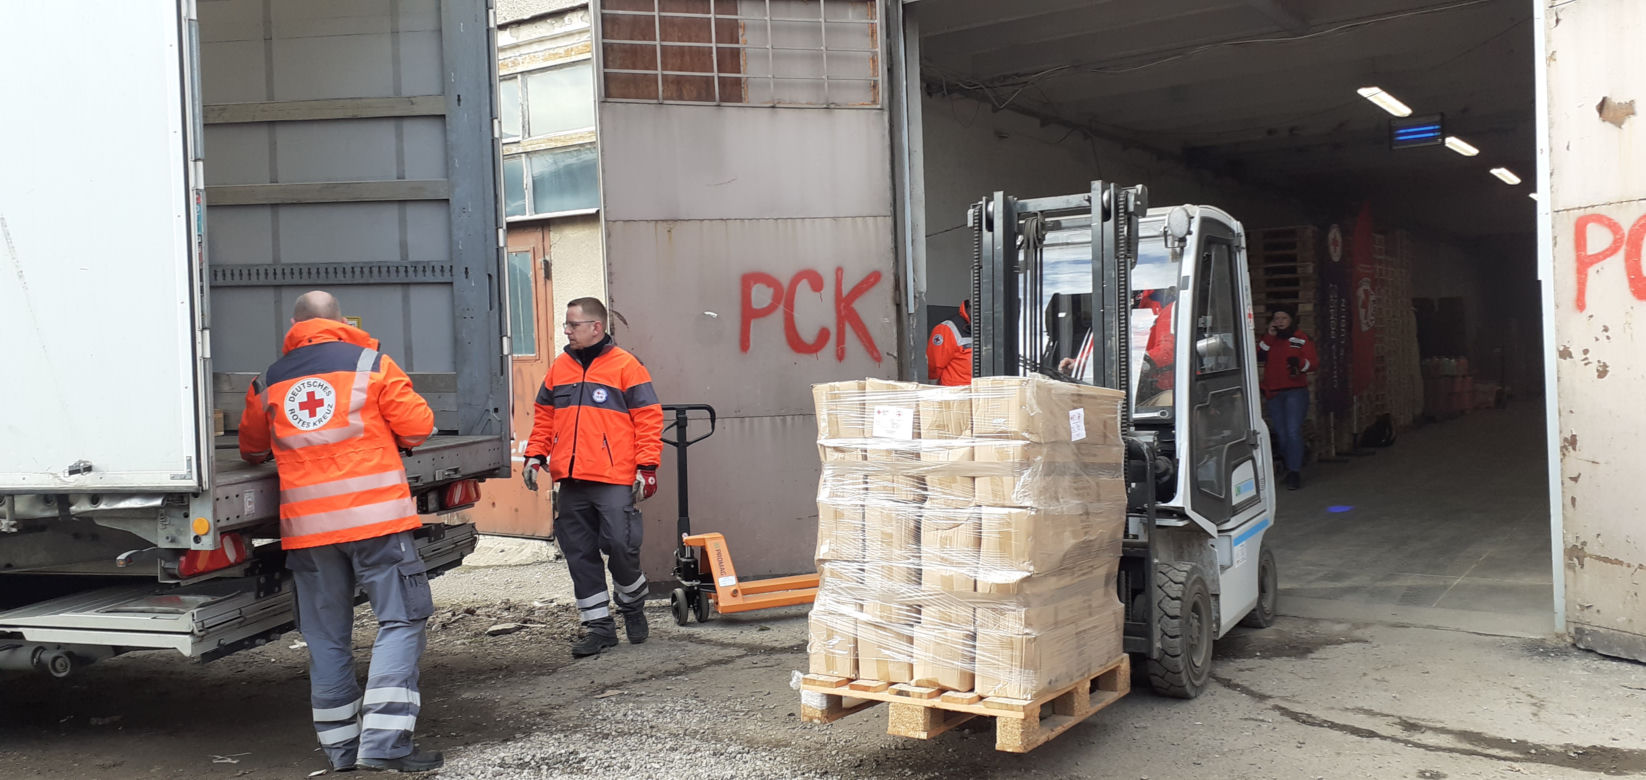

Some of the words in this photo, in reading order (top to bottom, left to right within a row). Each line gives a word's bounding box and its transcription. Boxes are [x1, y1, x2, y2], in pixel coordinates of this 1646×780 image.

[739, 266, 882, 365] PCK
[288, 380, 332, 402] DEUTSCHES
[288, 408, 311, 428] ROTES
[312, 403, 333, 427] KREUZ
